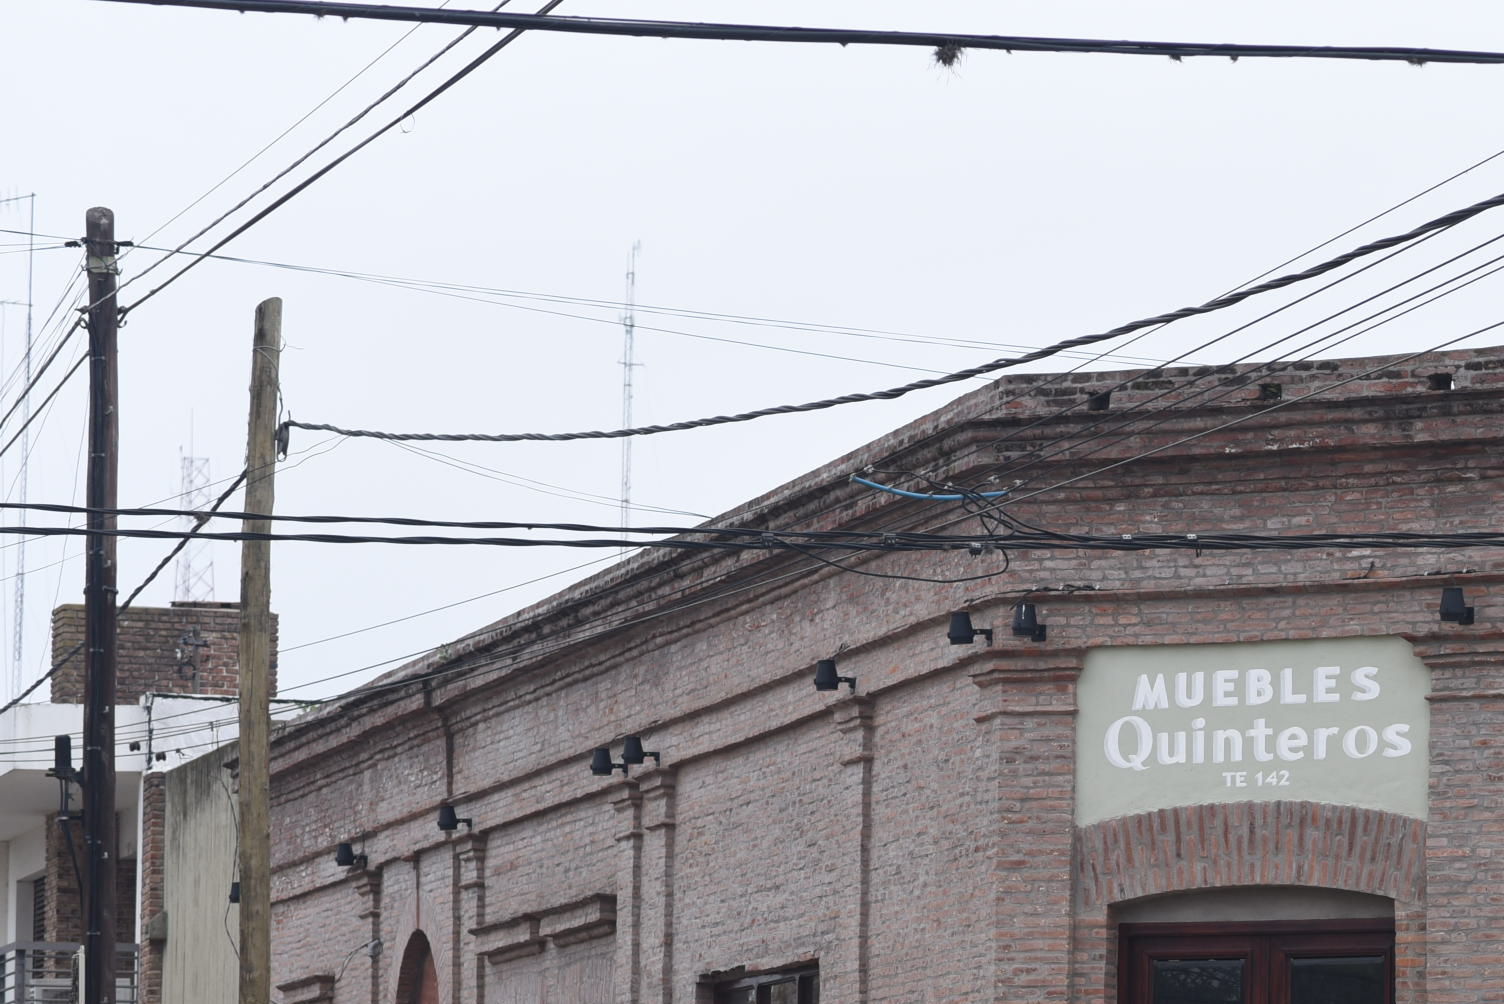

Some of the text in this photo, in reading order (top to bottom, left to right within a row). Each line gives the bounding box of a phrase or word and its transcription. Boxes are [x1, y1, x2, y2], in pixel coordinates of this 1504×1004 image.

[1132, 666, 1381, 711] MUEBLES
[1104, 716, 1412, 771] Quinteros
[1222, 770, 1290, 787] TE 142
